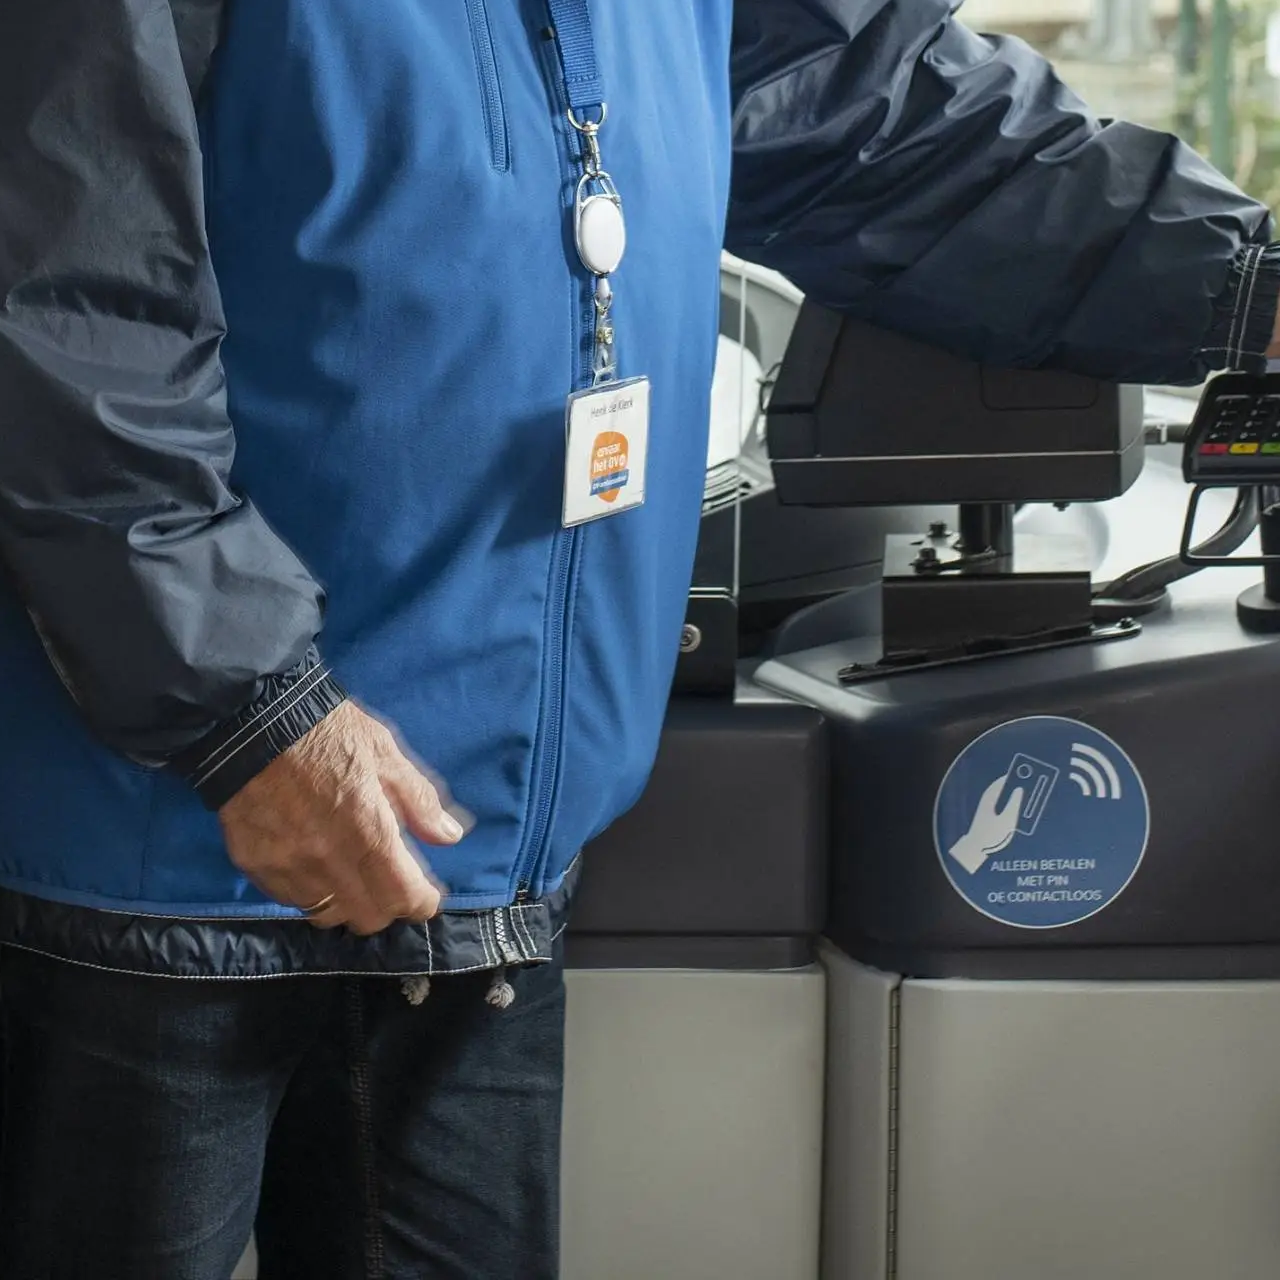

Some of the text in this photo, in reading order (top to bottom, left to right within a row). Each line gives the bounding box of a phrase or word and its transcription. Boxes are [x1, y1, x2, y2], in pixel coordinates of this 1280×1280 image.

[990, 858, 1096, 872] ALLEEN BETALEN
[1016, 874, 1070, 887] MET PIN
[1007, 889, 1103, 903] CONTACTLOOS
